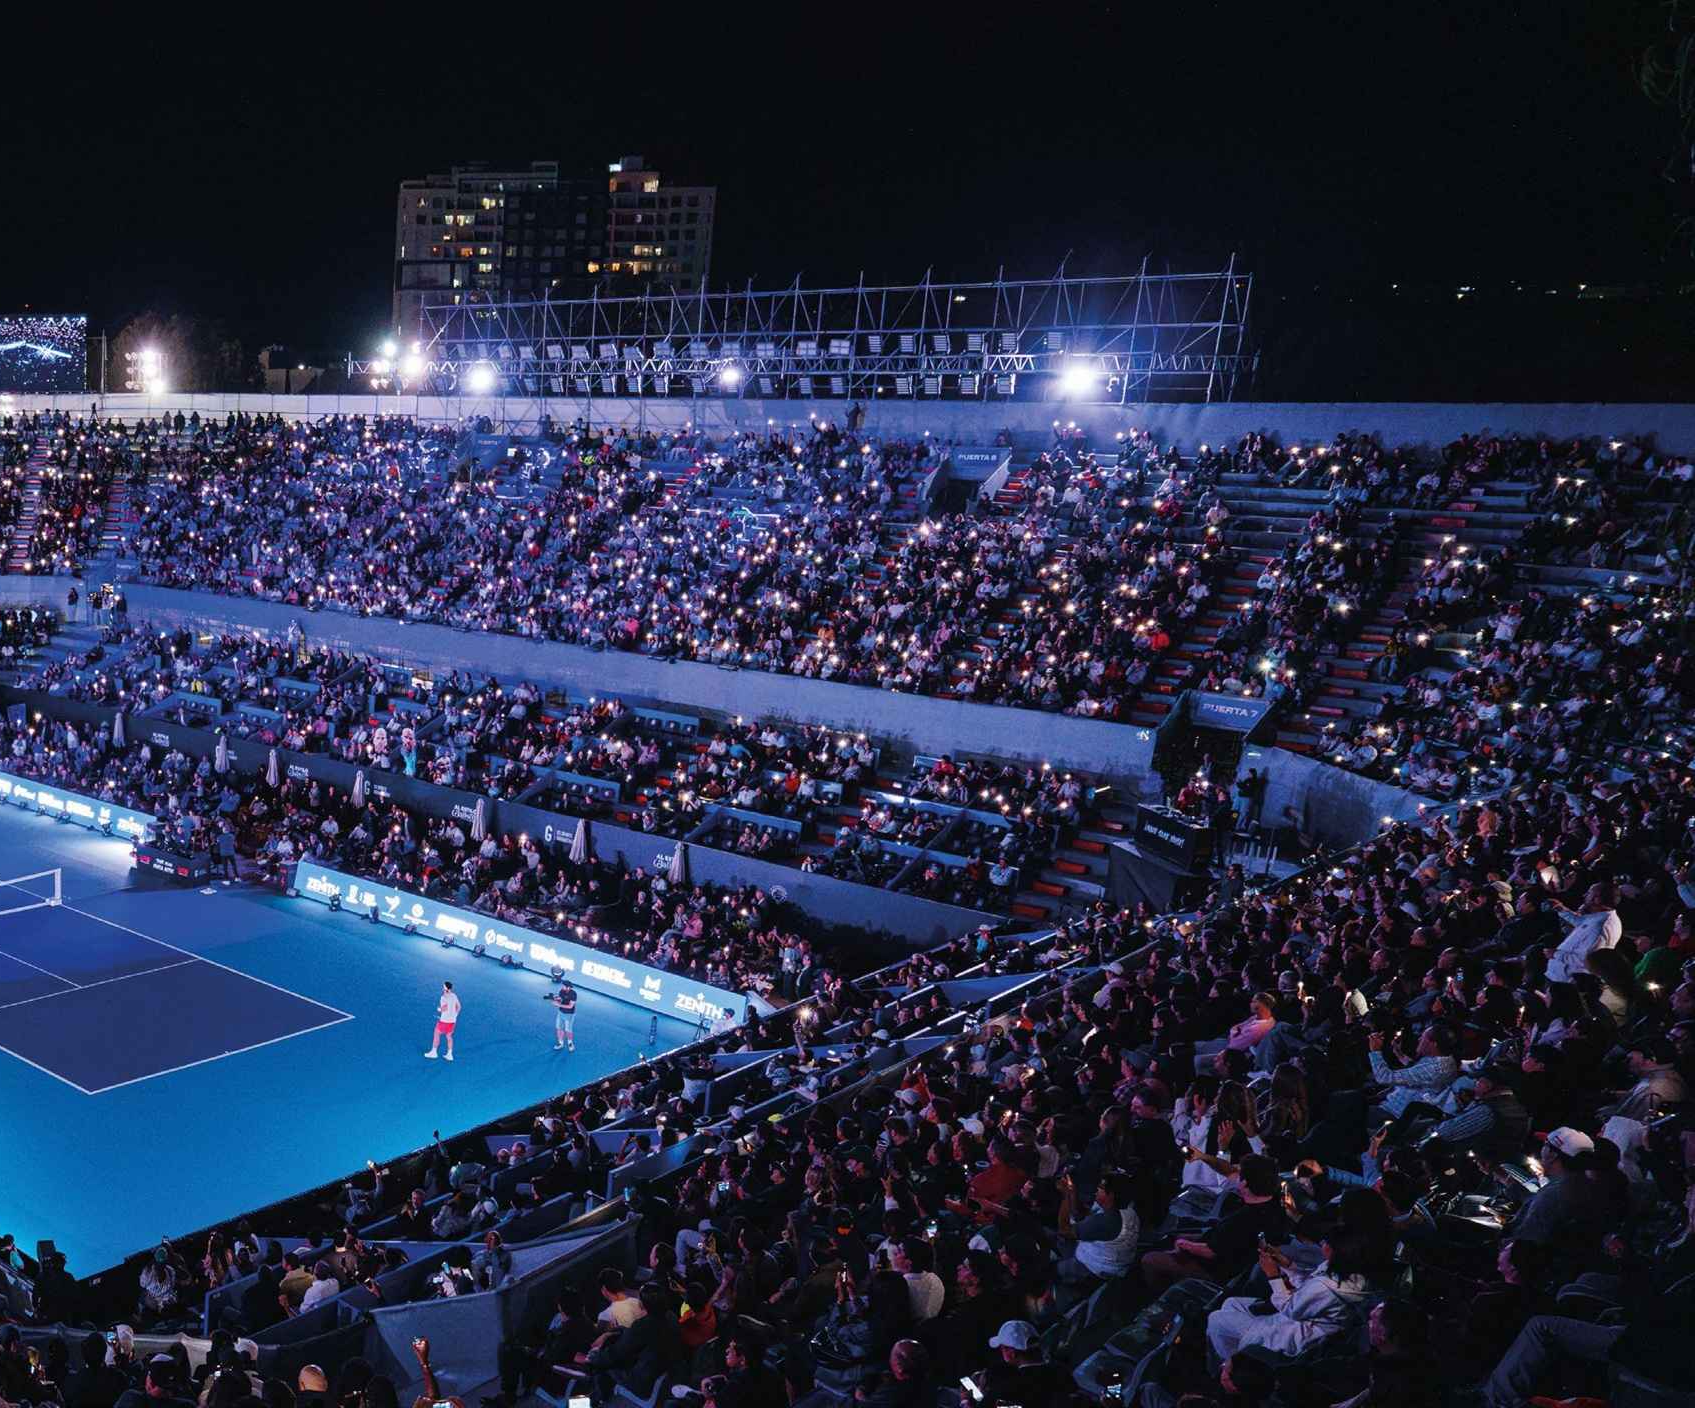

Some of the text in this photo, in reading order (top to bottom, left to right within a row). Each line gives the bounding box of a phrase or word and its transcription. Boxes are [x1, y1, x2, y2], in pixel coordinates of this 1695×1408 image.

[958, 453, 990, 461] PUERTA
[1202, 703, 1258, 718] PUERTA 7
[545, 825, 553, 842] G
[306, 877, 341, 897] ZENITH
[674, 992, 723, 1020] ZENITH
